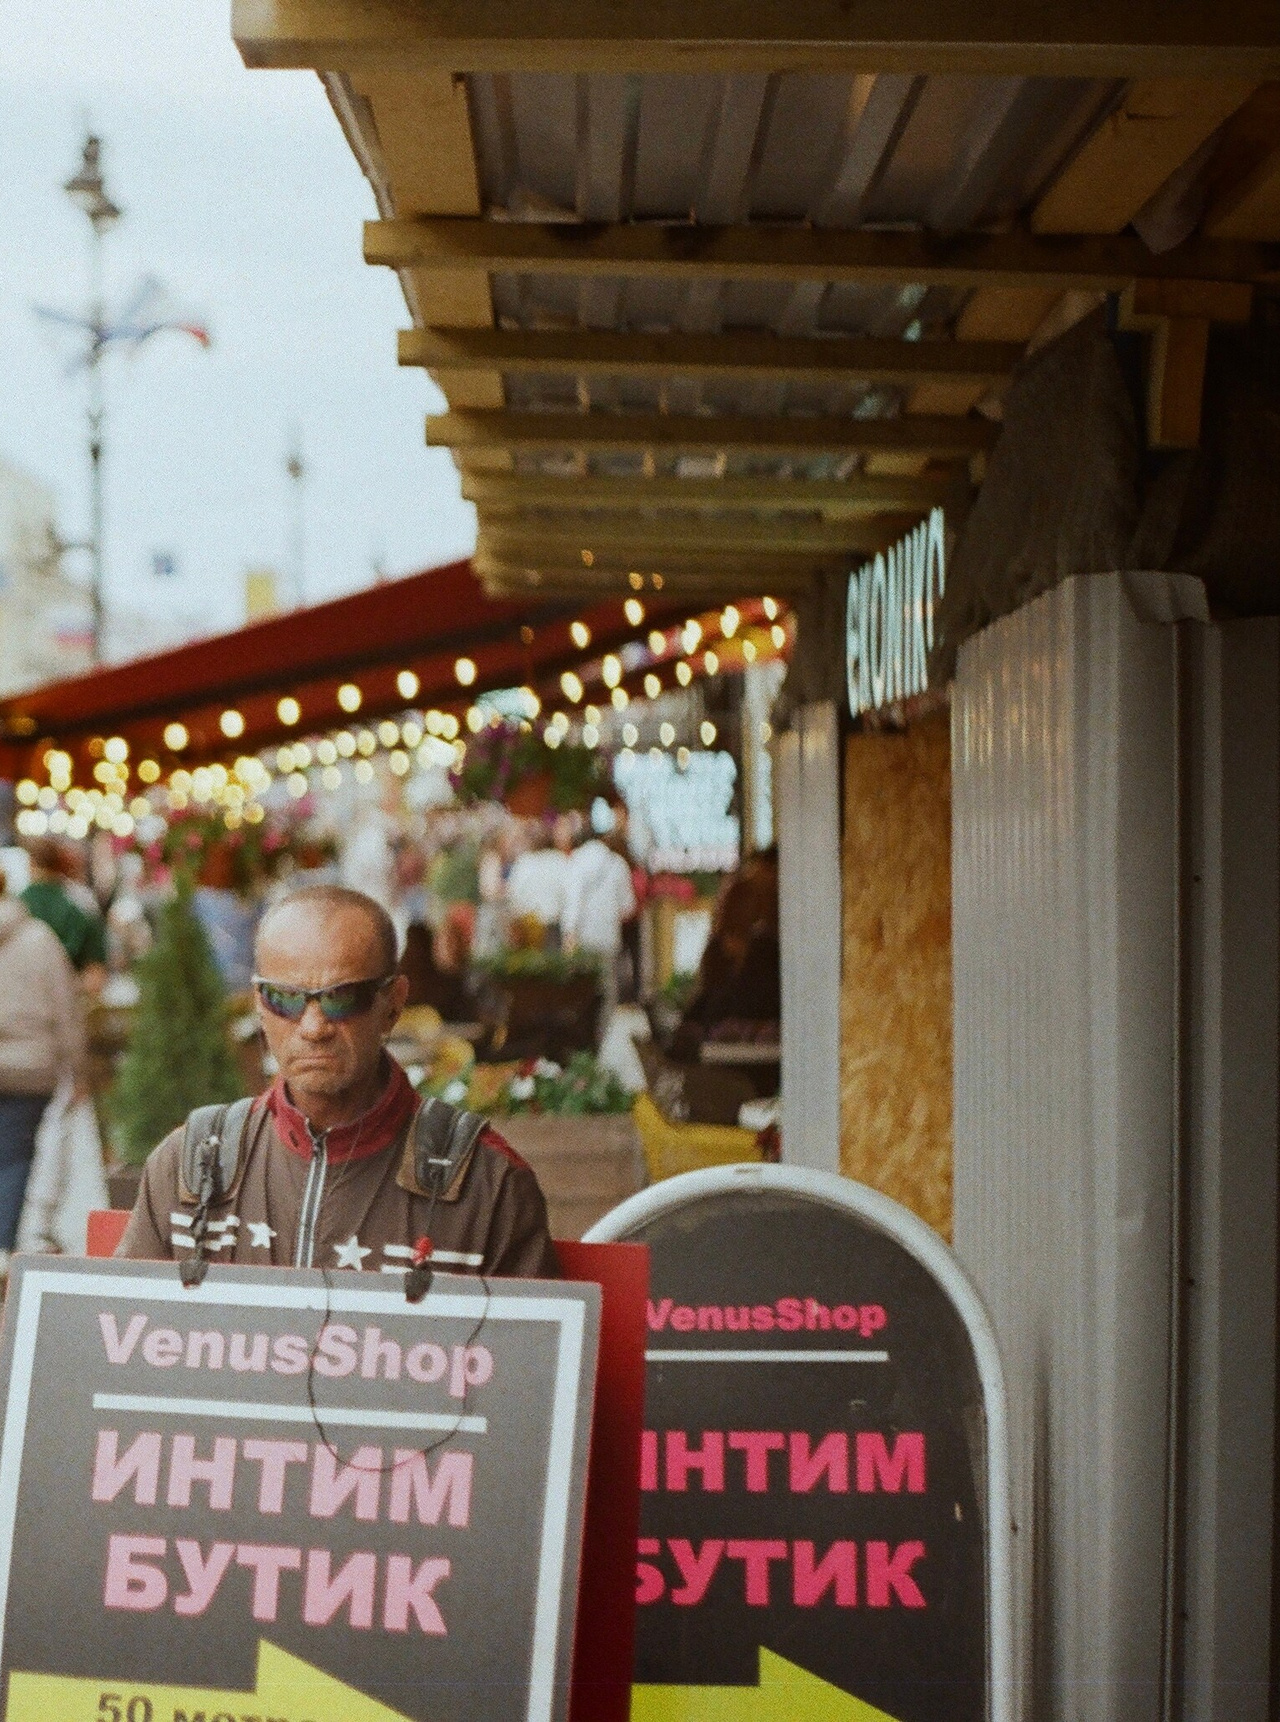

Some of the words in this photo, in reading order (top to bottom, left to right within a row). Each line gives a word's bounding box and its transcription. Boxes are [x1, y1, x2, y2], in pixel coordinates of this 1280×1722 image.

[97, 1311, 495, 1399] VenusShop
[646, 1297, 888, 1338] VenusShop
[91, 1429, 474, 1529] ИНТИМ
[103, 1532, 452, 1638] БУТИК
[98, 1692, 153, 1722] 50
